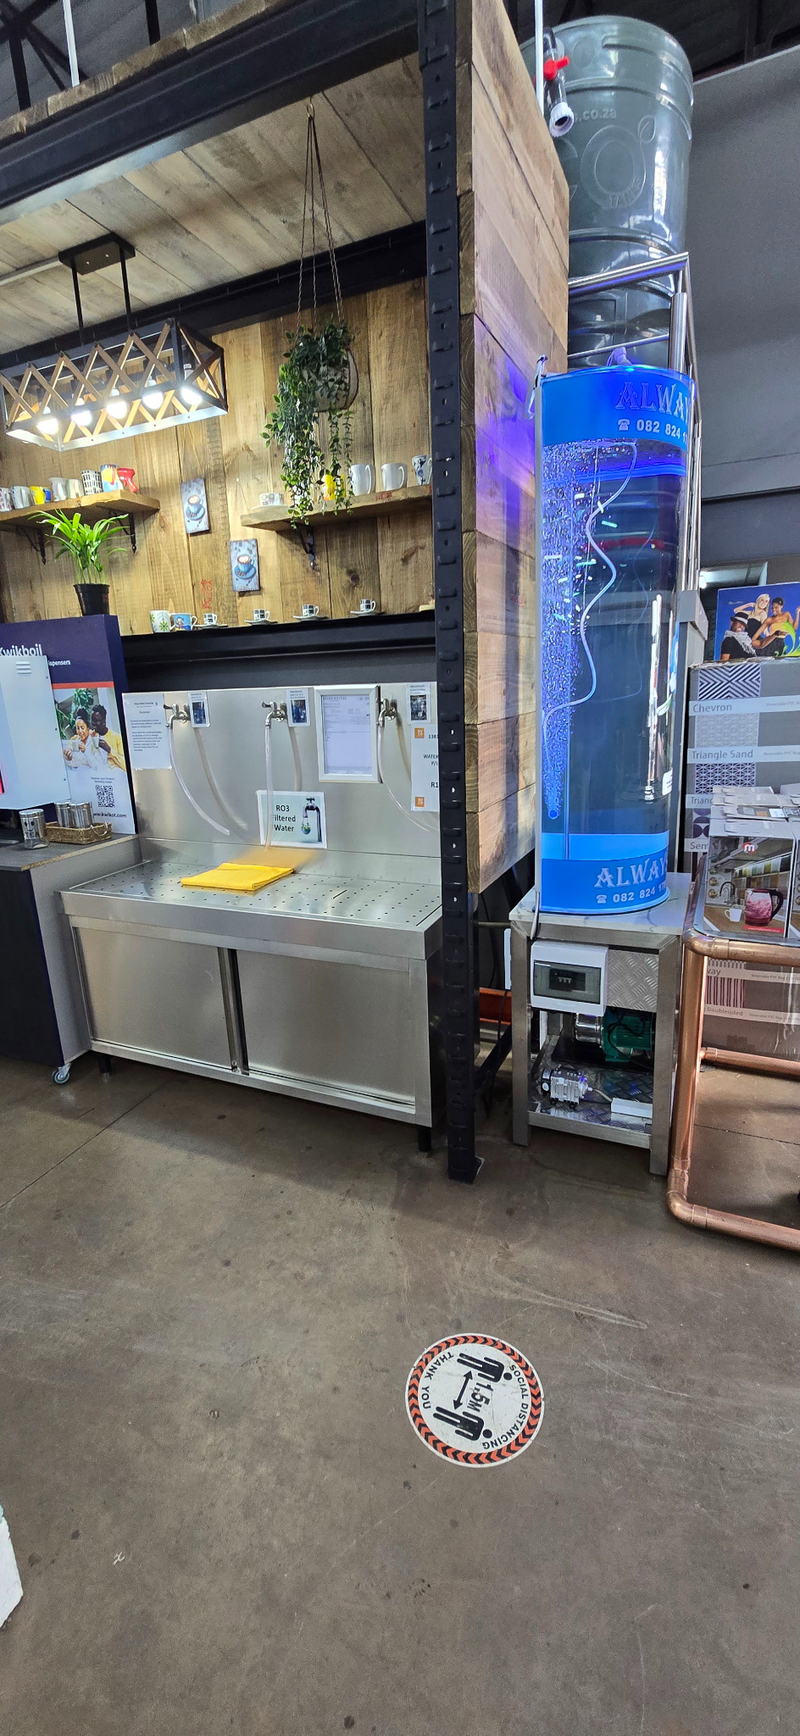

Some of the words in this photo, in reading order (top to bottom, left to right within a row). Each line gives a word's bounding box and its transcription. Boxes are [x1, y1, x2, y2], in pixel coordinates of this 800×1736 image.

[636, 418, 660, 433] 082
[665, 423, 681, 439] 824
[692, 704, 732, 713] Chevron
[692, 751, 728, 760] Triangle
[730, 749, 754, 758] Sand
[275, 804, 290, 812] RO3
[273, 824, 295, 832] Water
[612, 891, 635, 903] 082
[639, 886, 656, 899] 824
[706, 1006, 744, 1017] Doublesided
[424, 1351, 455, 1380] THANK
[508, 1363, 530, 1400] SOCIAL
[421, 1385, 432, 1410] YOU
[481, 1402, 530, 1450] DISTANCING
